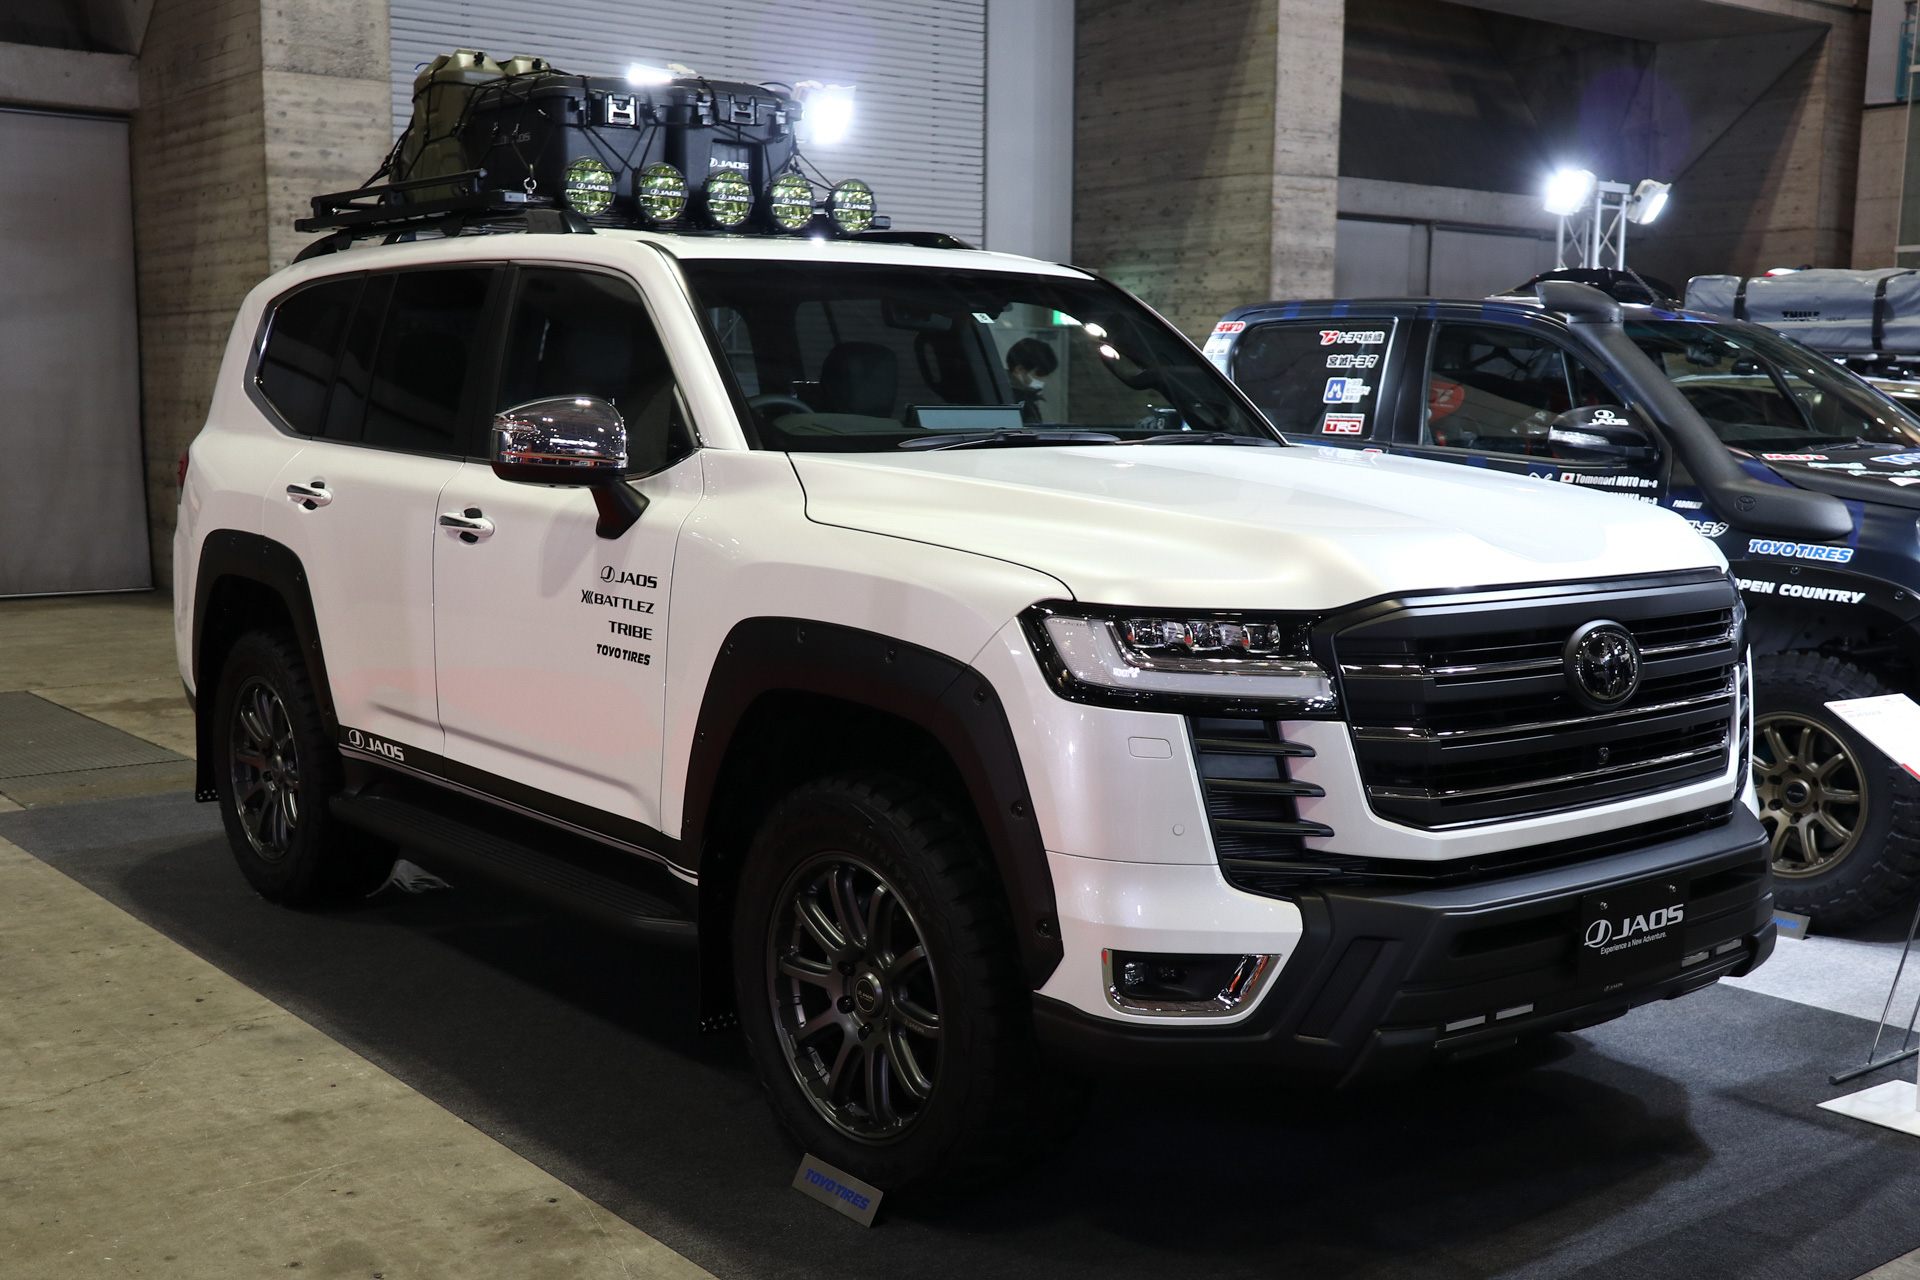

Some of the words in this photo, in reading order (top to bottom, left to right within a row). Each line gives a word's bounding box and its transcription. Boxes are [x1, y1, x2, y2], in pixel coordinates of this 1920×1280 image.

[717, 160, 749, 170] JAOS
[1326, 420, 1360, 432] TRD
[1575, 474, 1616, 486] Tomonori
[1616, 475, 1640, 488] NOTO
[1749, 540, 1795, 555] TOYO
[1796, 544, 1853, 562] TIRES
[615, 571, 658, 589] JAOS
[594, 593, 655, 614] BATTLEZ
[1779, 584, 1866, 604] COUNTRY
[608, 620, 653, 641] TRIBE
[596, 643, 621, 659] TOYO
[622, 649, 651, 666] TIRES
[366, 737, 405, 761] JAOS
[1612, 903, 1684, 941] JAOS
[1600, 942, 1627, 955] Experience
[1631, 938, 1642, 947] New
[805, 1168, 837, 1193] TOYO
[834, 1183, 871, 1210] TIRES
